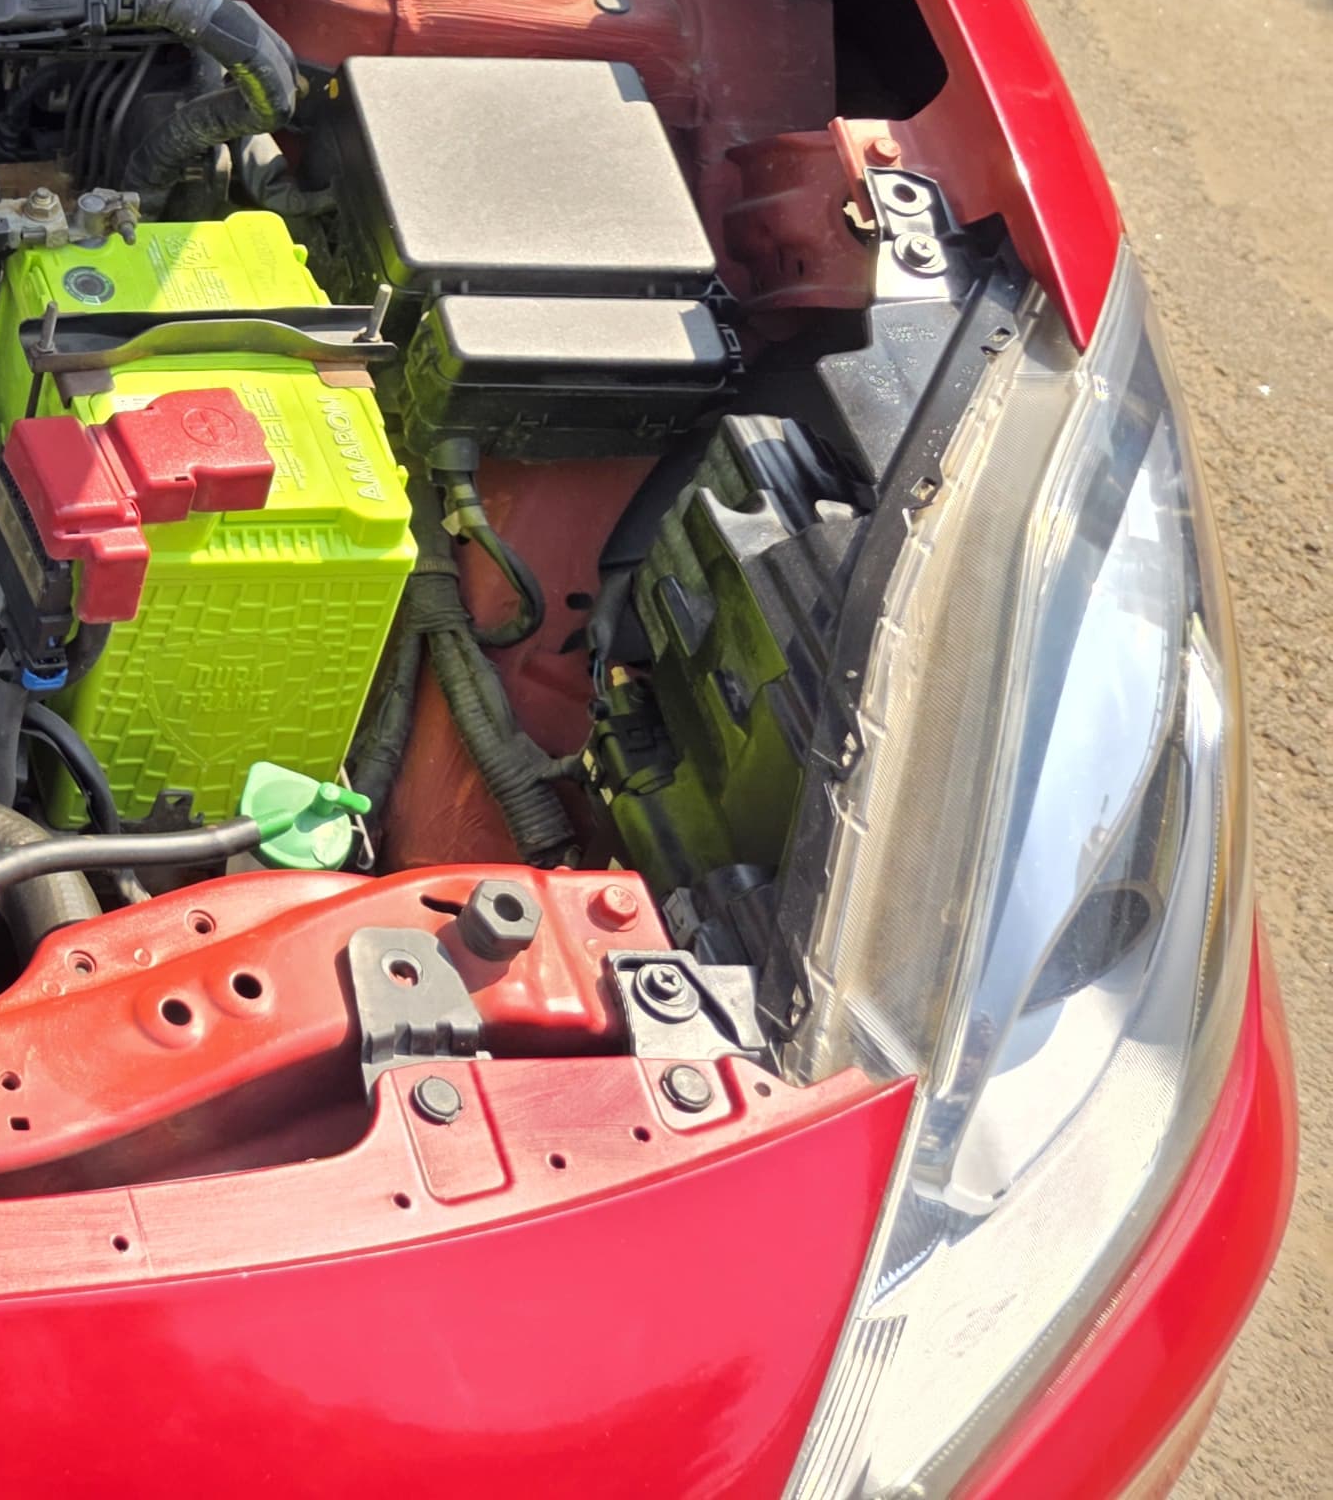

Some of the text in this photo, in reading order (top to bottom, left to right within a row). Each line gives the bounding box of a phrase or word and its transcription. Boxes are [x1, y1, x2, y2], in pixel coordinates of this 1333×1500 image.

[317, 395, 385, 501] AMARON
[196, 666, 263, 690] DURA
[179, 689, 274, 713] FRAME
